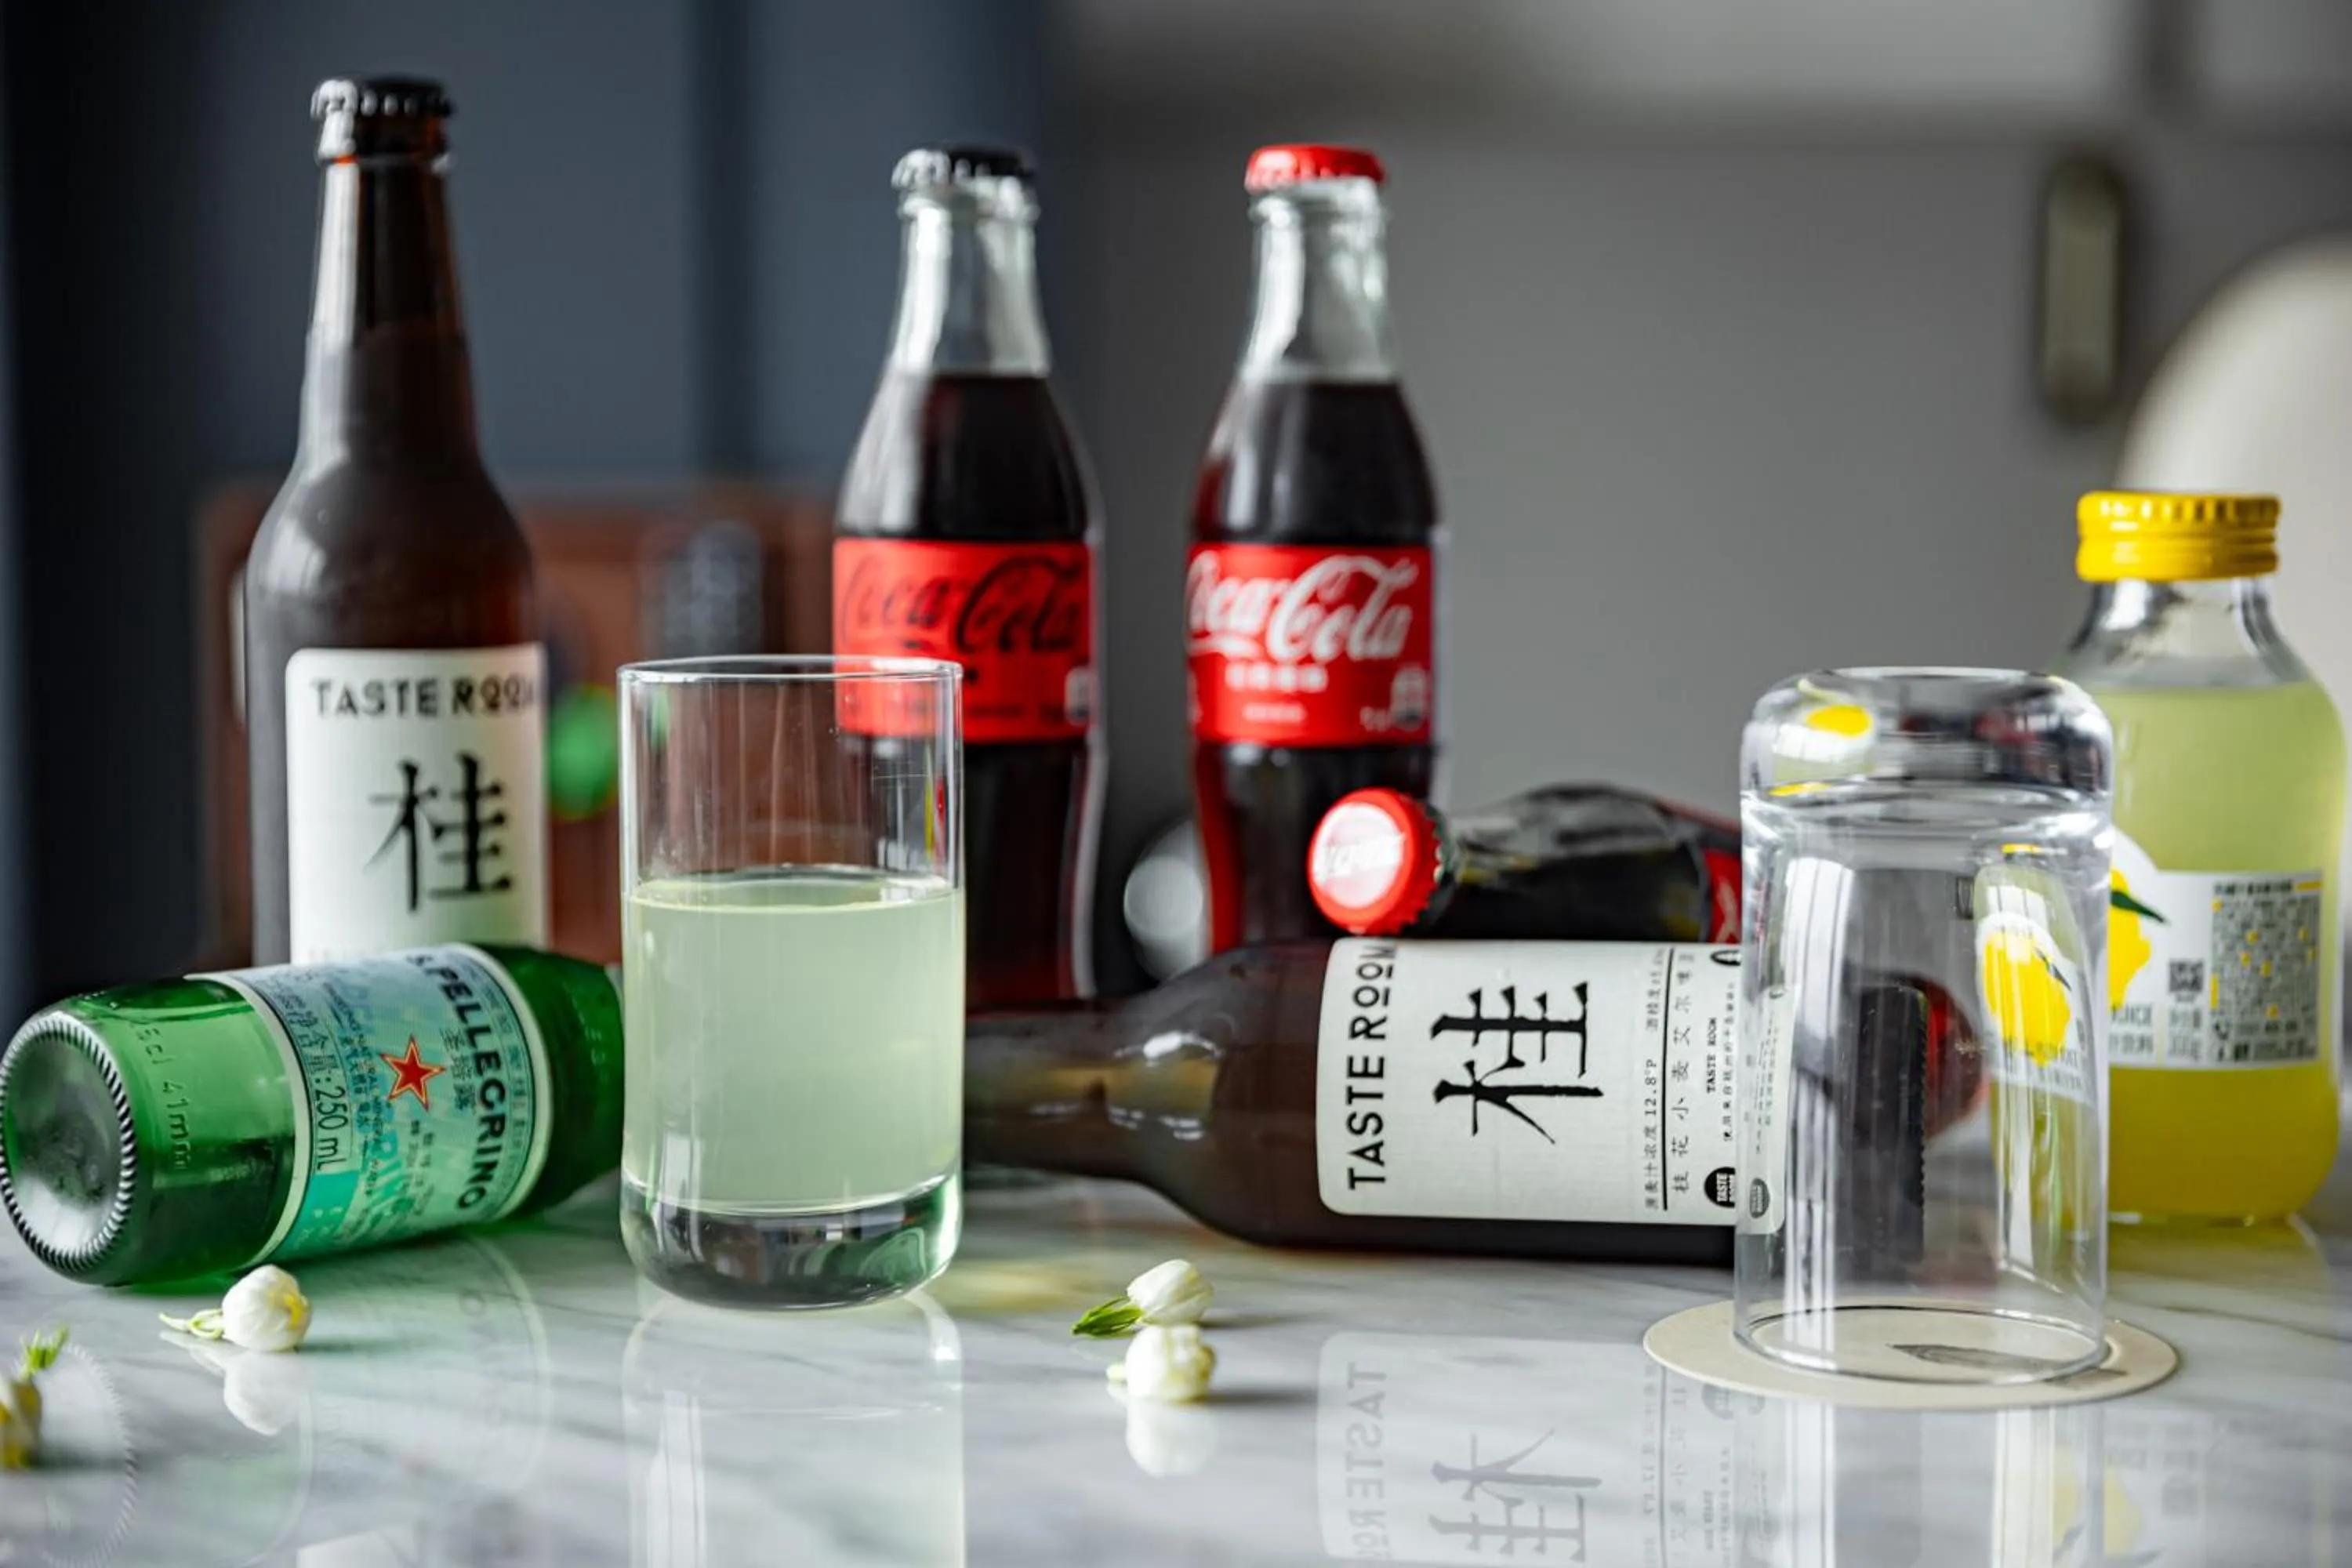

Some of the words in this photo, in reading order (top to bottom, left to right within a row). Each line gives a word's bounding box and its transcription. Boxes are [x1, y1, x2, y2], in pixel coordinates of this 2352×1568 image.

[312, 675, 439, 718] TASTE
[363, 750, 515, 915] 桂
[1345, 1055, 1387, 1190] TASTE
[1430, 981, 1604, 1145] 桂
[1706, 1054, 1717, 1094] TASTE
